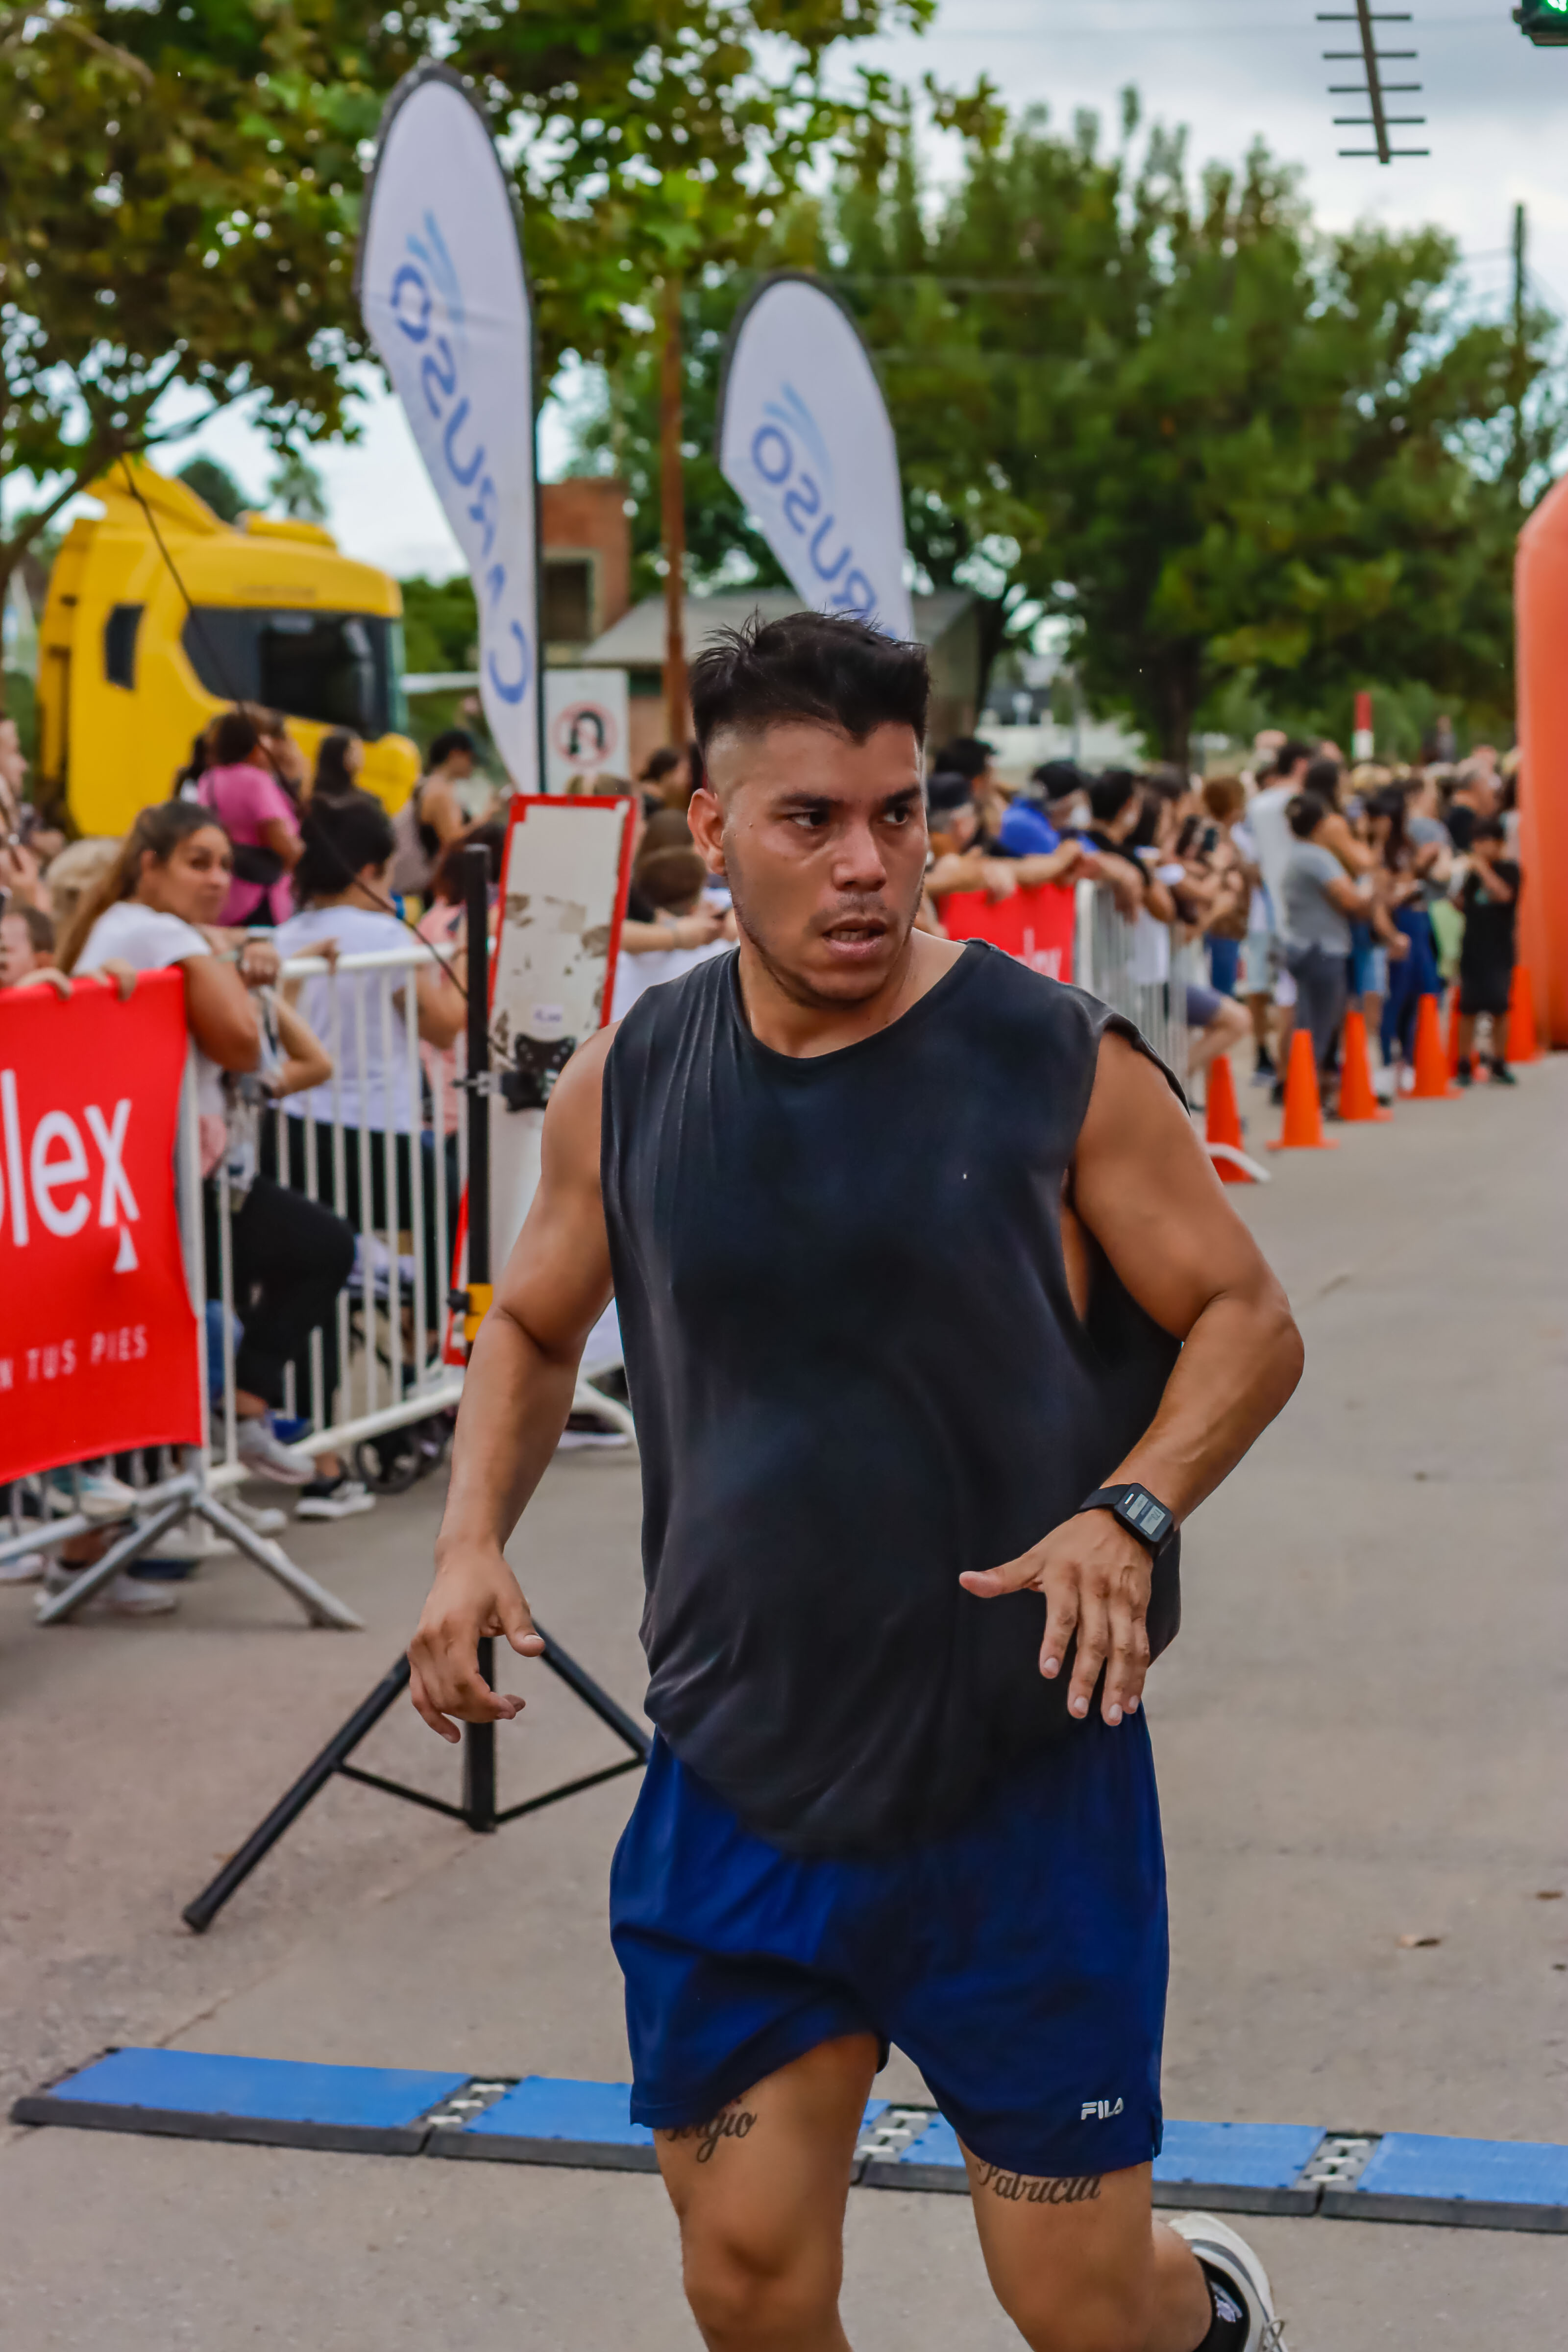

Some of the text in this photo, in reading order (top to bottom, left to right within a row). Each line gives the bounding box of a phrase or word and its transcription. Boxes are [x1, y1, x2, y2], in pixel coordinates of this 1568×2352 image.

[0, 1068, 140, 1247] lex
[26, 1338, 77, 1383] TUS
[90, 1324, 148, 1366] PIES
[1081, 2097, 1124, 2120] FILA
